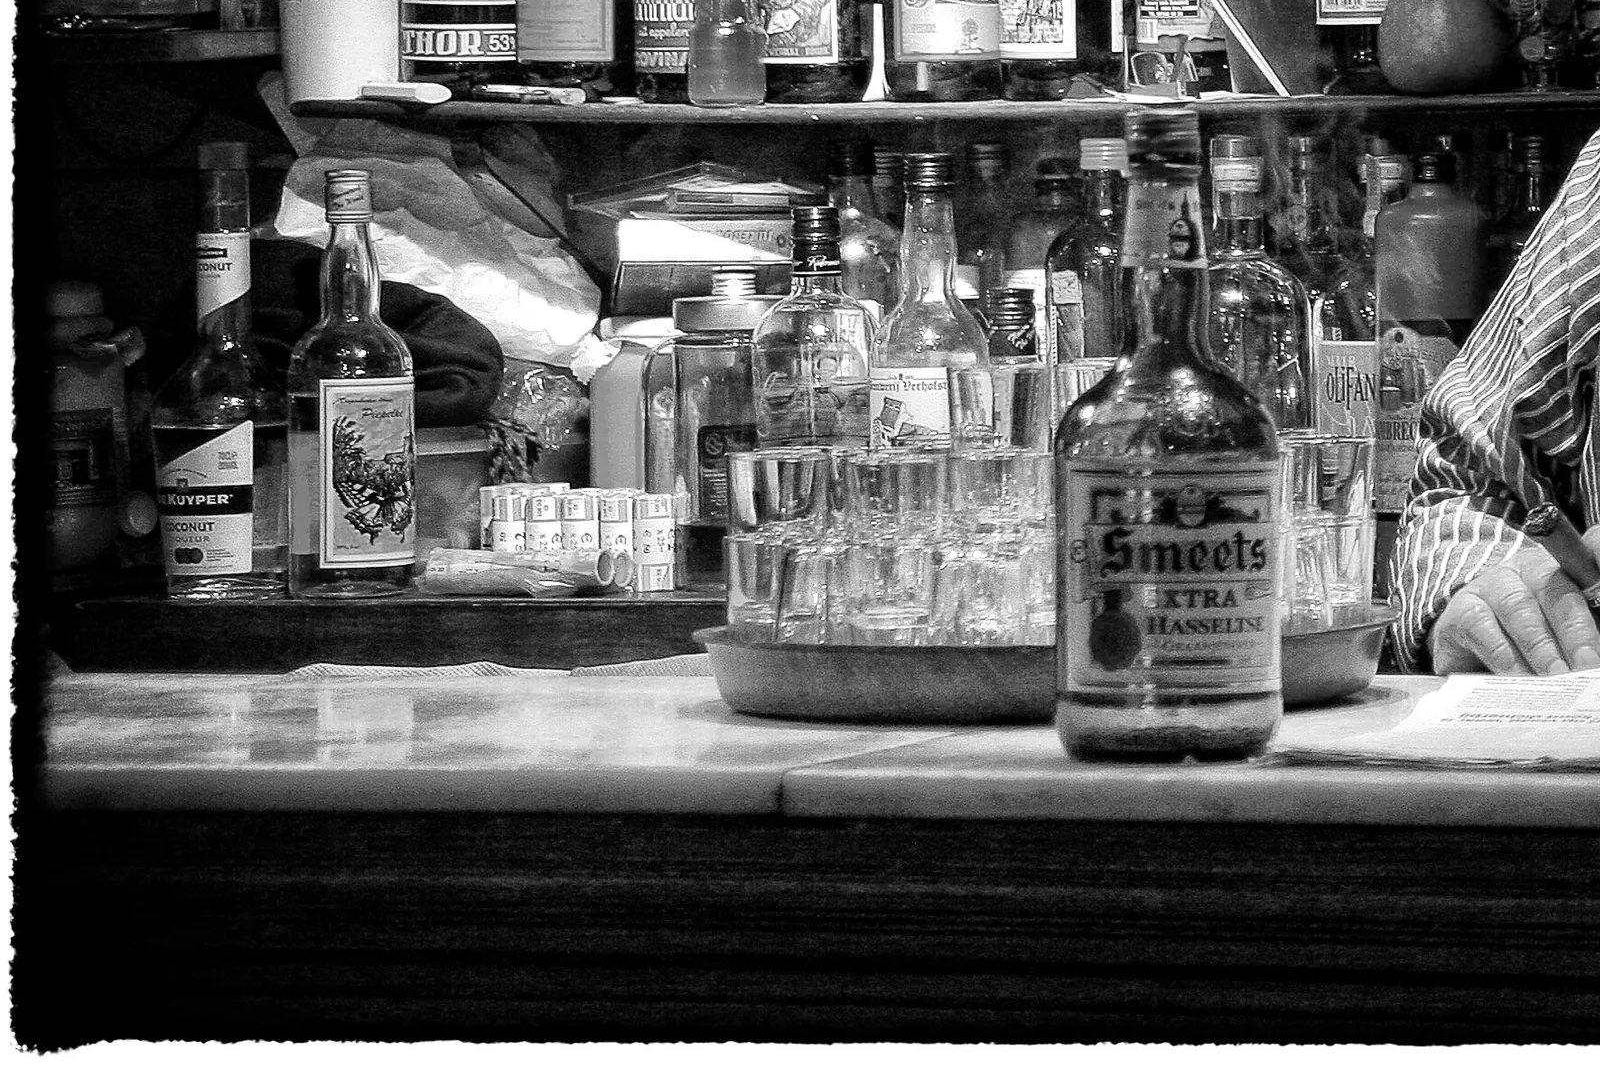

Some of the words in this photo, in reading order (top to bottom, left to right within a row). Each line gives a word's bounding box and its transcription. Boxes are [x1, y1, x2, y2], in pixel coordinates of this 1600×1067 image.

[402, 29, 485, 56] THOR
[167, 493, 231, 505] KUYPER
[1100, 526, 1268, 579] Smeets
[1143, 586, 1240, 609] EXTRA
